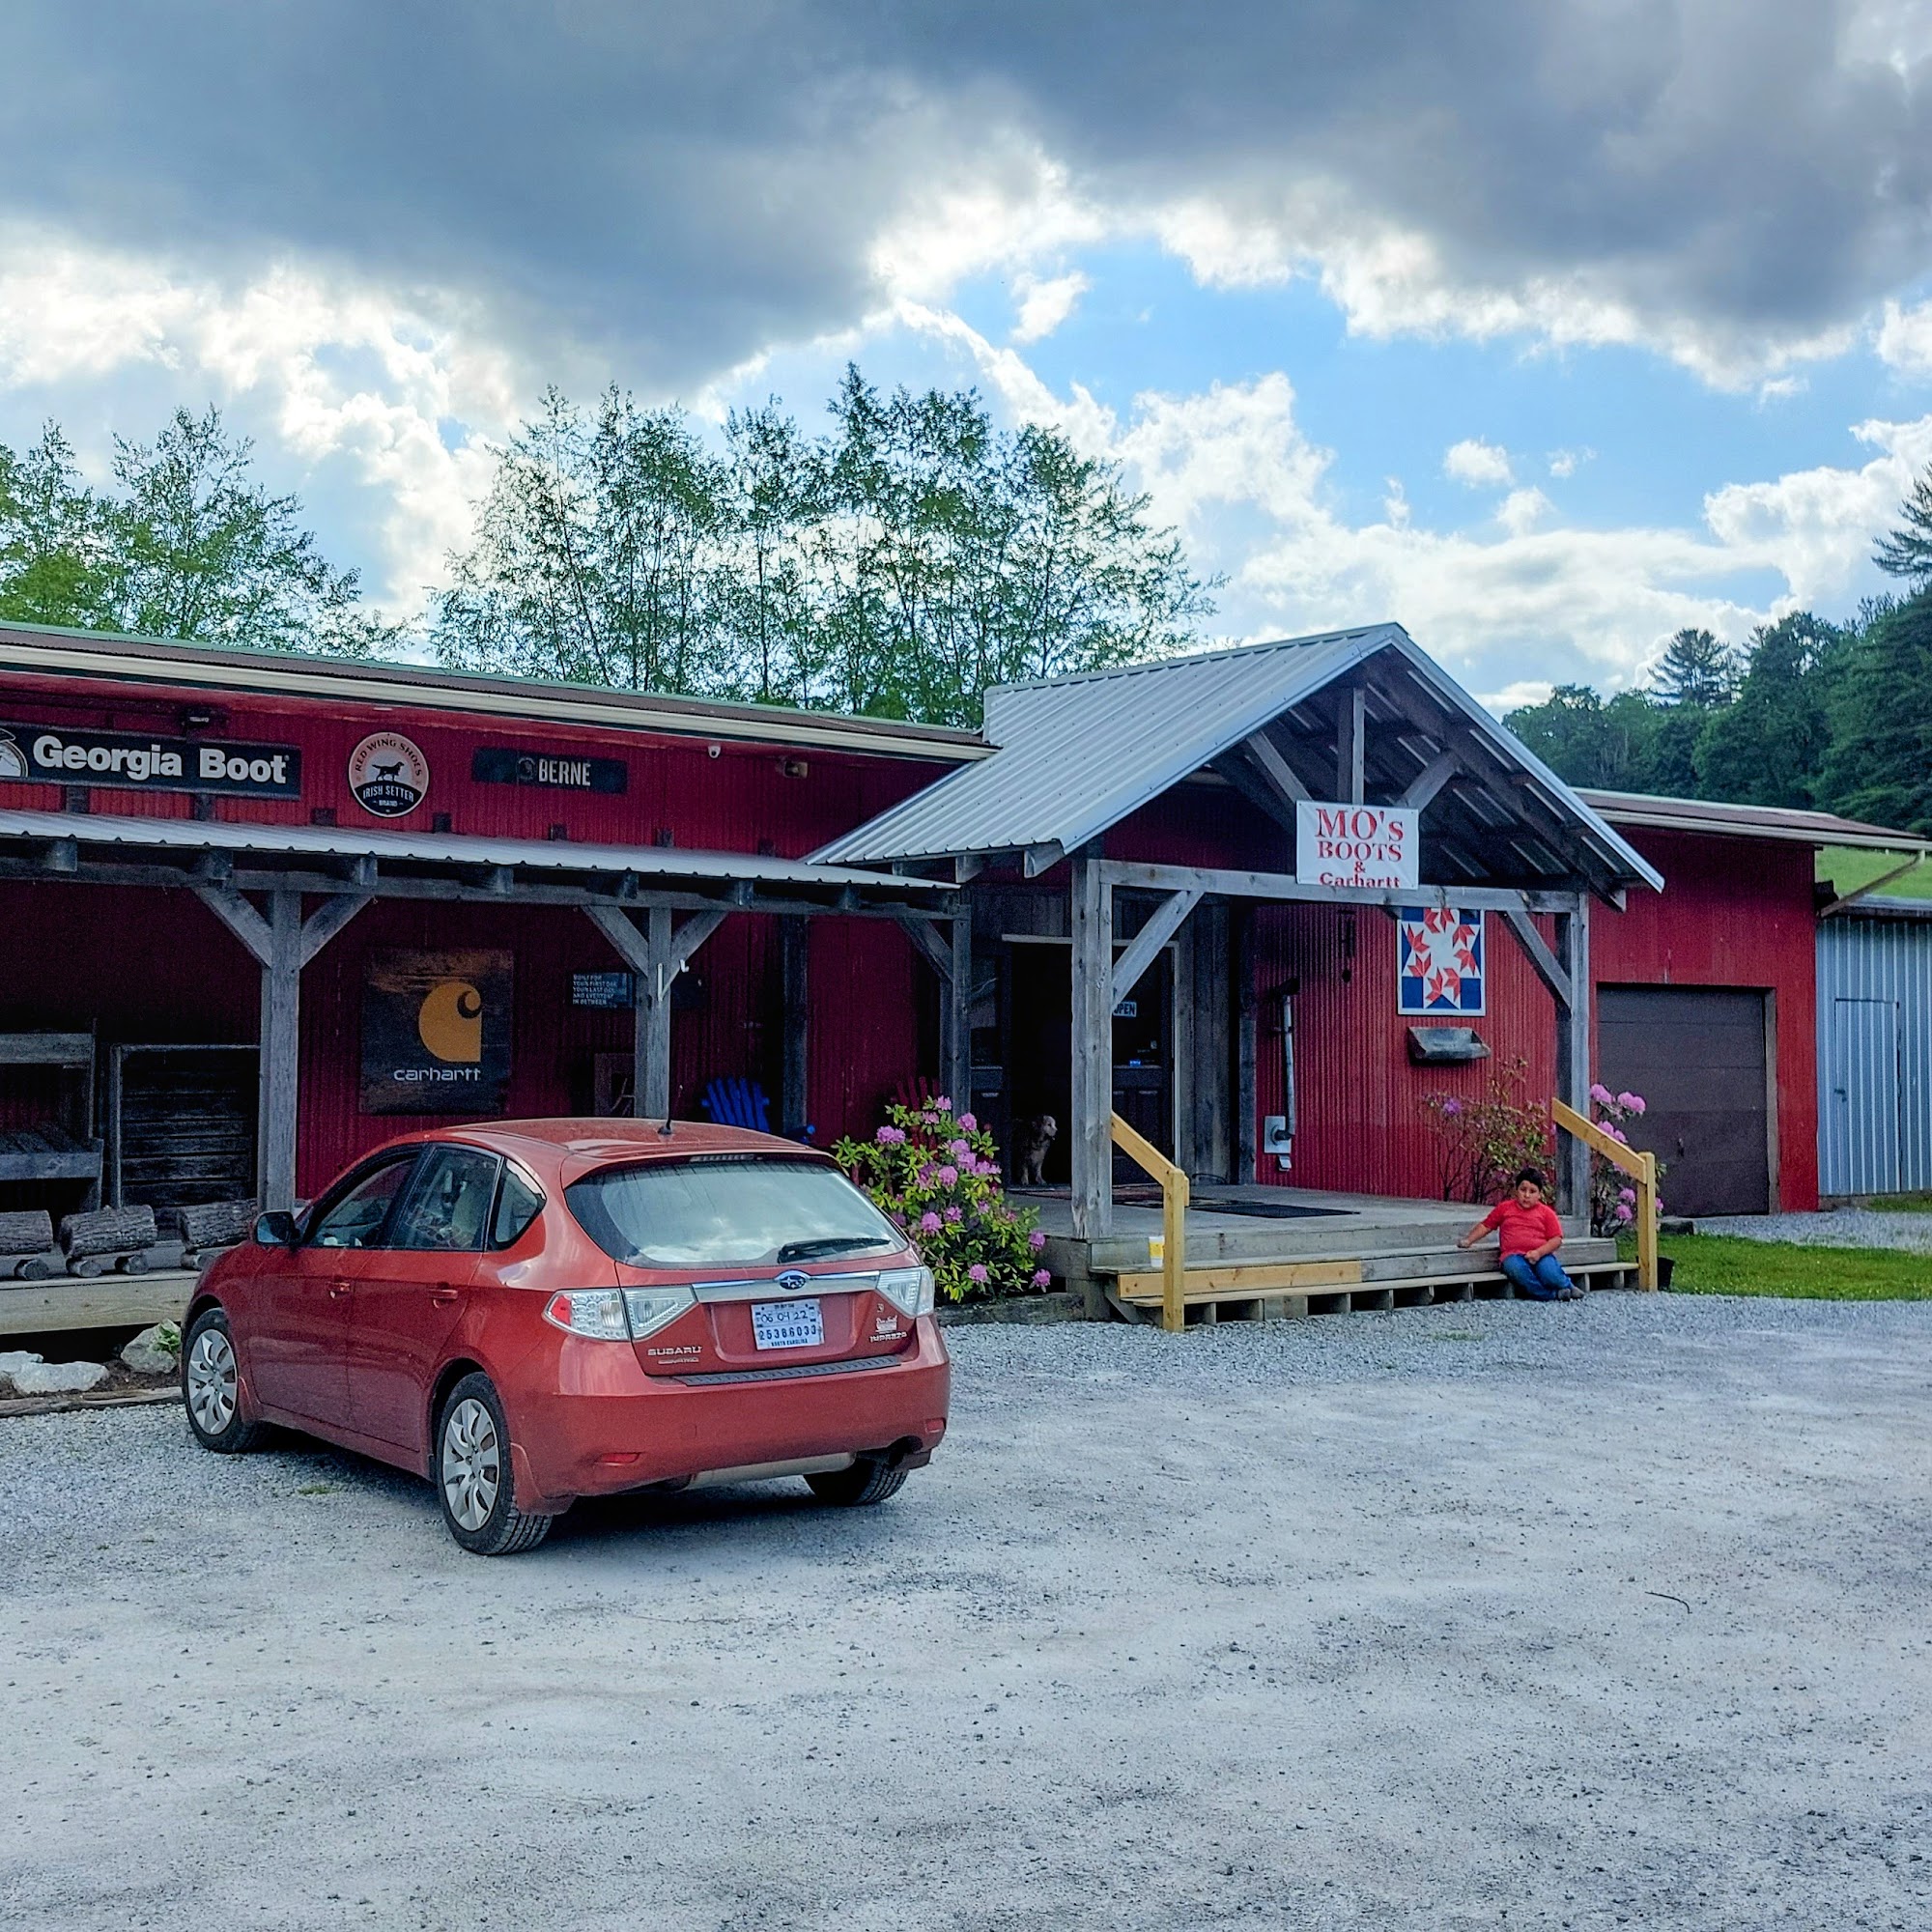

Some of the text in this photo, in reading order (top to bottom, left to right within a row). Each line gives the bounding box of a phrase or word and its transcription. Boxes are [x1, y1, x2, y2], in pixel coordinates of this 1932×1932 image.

[33, 735, 287, 783] Georgia Boot
[355, 739, 422, 776] RED WING SHOES
[538, 758, 591, 786] BERNE
[363, 785, 414, 803] IRISH SETTER
[1315, 809, 1404, 841] MO's
[1318, 840, 1402, 862] BOOTS
[1354, 861, 1366, 873] &
[1320, 872, 1400, 888] Carhartt
[393, 1067, 481, 1081] carhartt
[777, 1311, 790, 1321] 04
[794, 1310, 809, 1321] 22
[647, 1346, 702, 1356] SUBARU
